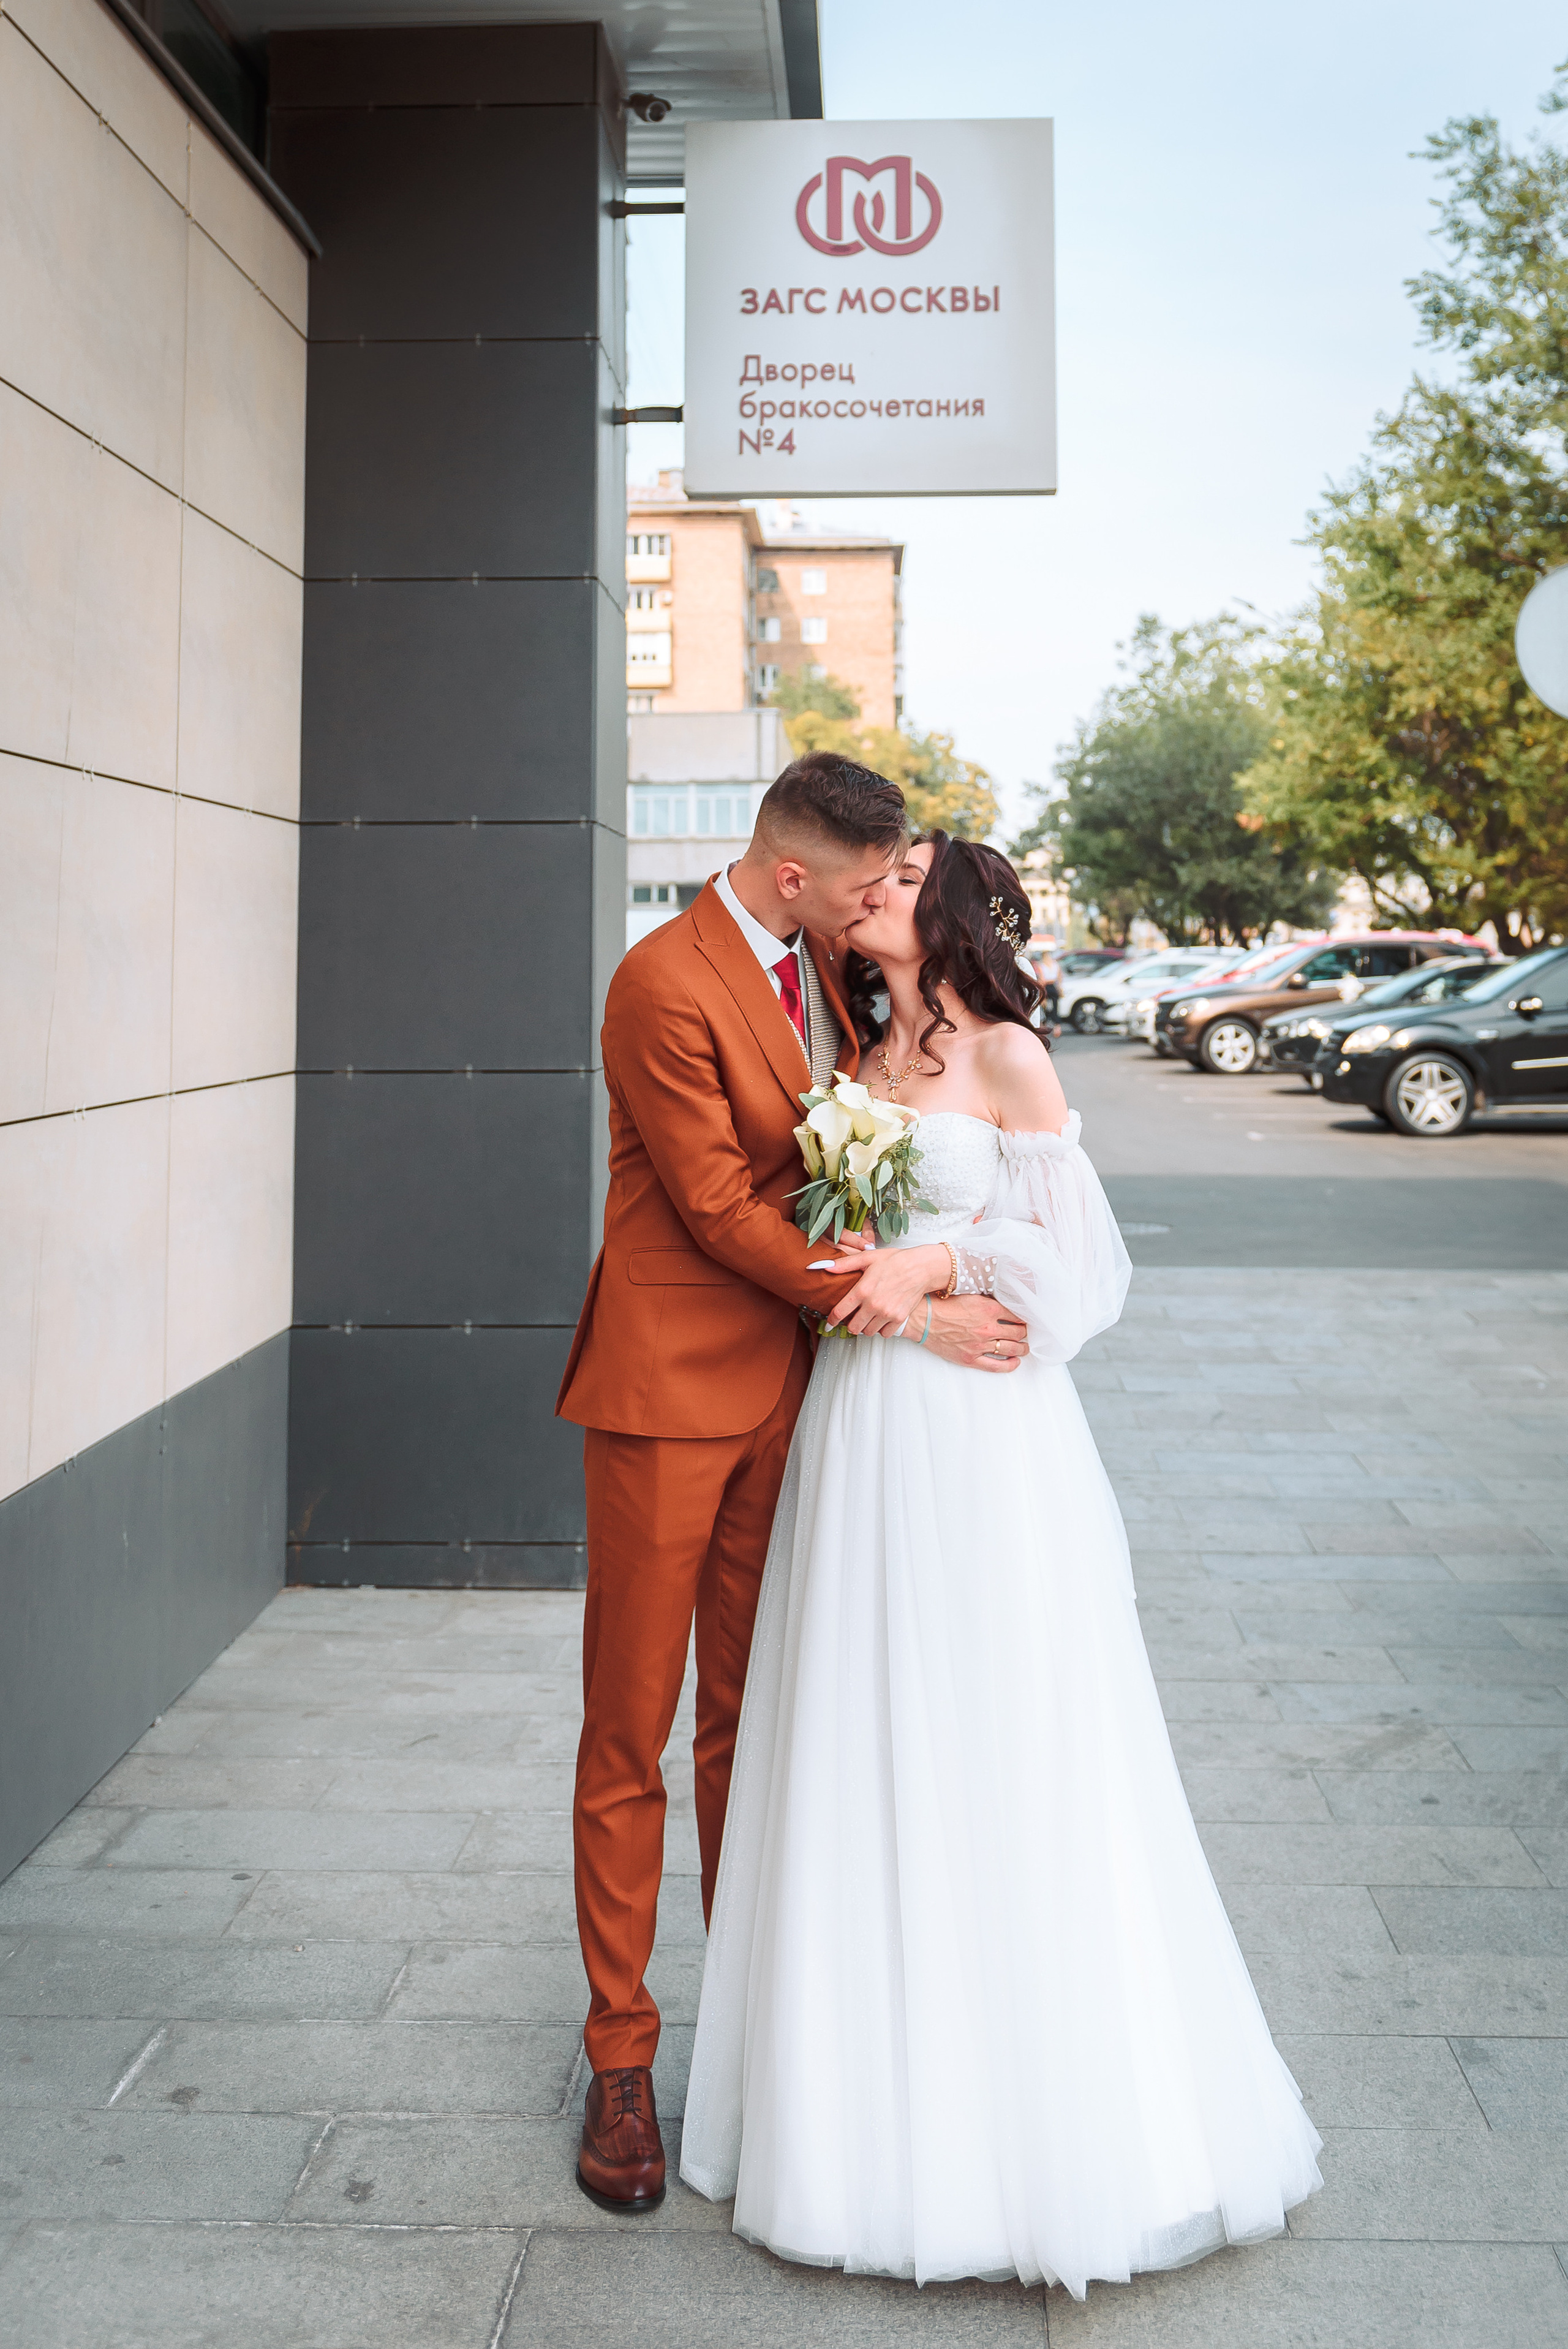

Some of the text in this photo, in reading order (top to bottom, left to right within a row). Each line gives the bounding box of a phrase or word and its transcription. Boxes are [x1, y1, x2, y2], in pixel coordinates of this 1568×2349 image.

[740, 286, 1000, 314] ЗАГС МОСКВЫ
[739, 354, 855, 389] Дворец
[739, 391, 986, 426] бракосочетания
[738, 428, 796, 455] №4
